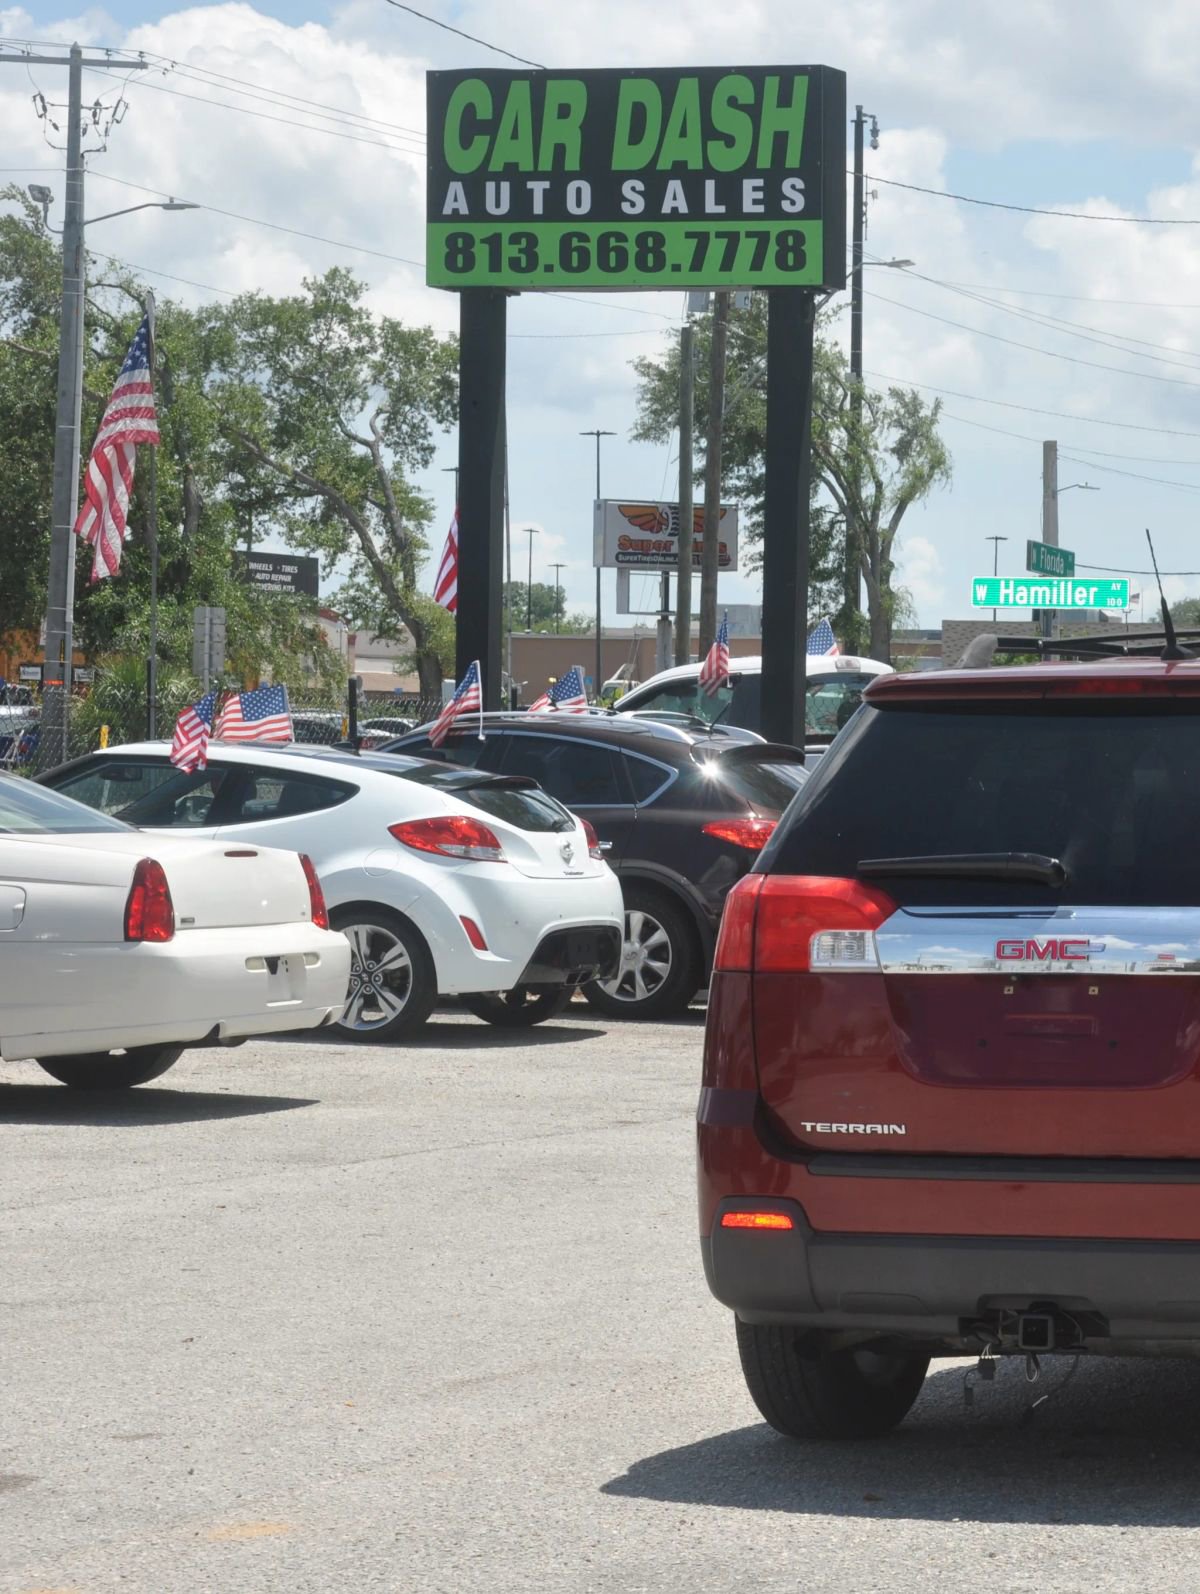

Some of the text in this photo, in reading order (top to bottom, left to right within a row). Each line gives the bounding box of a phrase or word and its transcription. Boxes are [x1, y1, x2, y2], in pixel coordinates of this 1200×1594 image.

[443, 74, 809, 174] CAR DASH
[442, 177, 806, 215] AUTO SALES
[444, 229, 807, 273] 813.668.7778
[618, 535, 673, 555] Super
[248, 562, 298, 573] WHEELS TIRES
[1040, 547, 1064, 575] Florida
[255, 573, 292, 582] AUTO REPAIR
[976, 584, 988, 601] W
[999, 579, 1099, 606] Hamiller
[1106, 597, 1122, 606] 100
[996, 939, 1089, 961] GMC
[800, 1121, 906, 1135] TERRAIN
